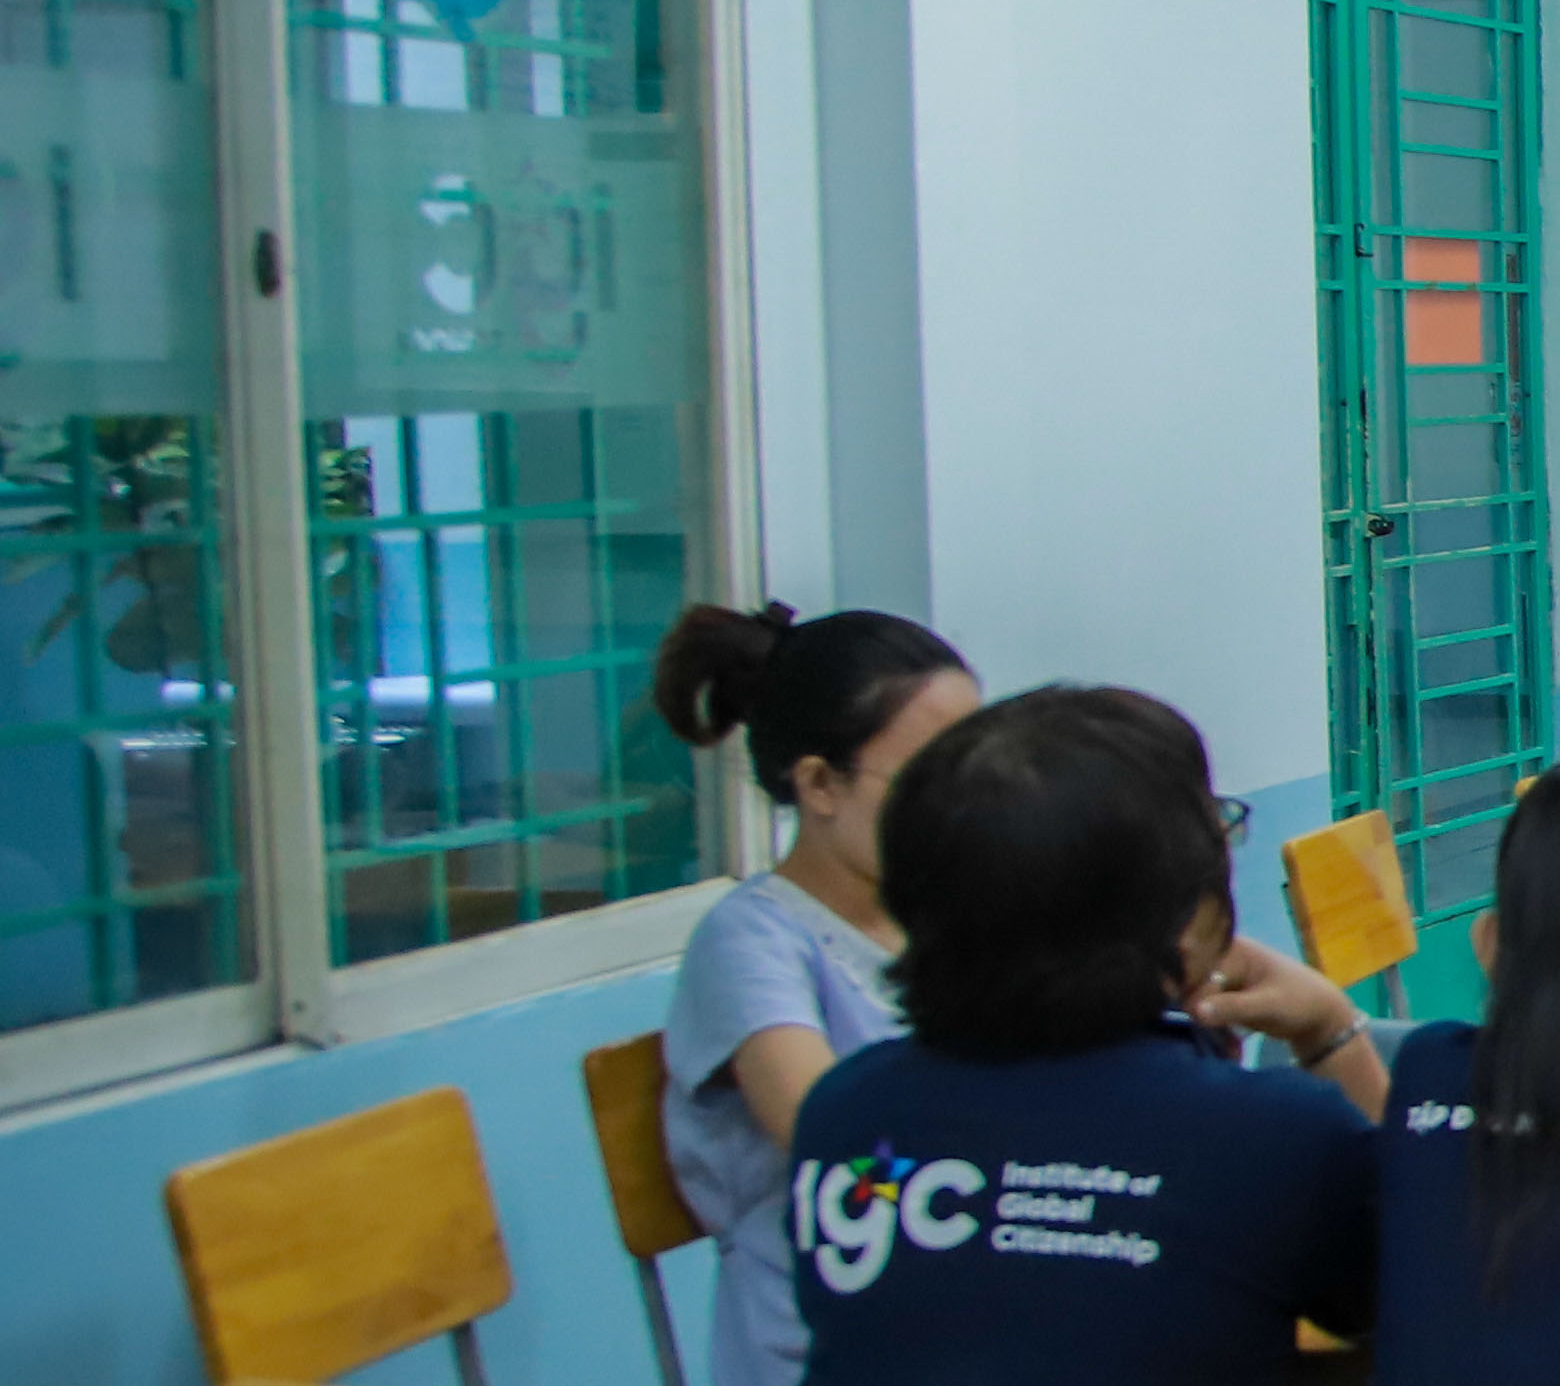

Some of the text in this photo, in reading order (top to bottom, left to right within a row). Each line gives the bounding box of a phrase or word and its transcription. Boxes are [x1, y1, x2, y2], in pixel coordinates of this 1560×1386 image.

[1002, 1160, 1163, 1197] Institute of
[996, 1192, 1095, 1223] Global
[991, 1223, 1161, 1267] Citizenship
